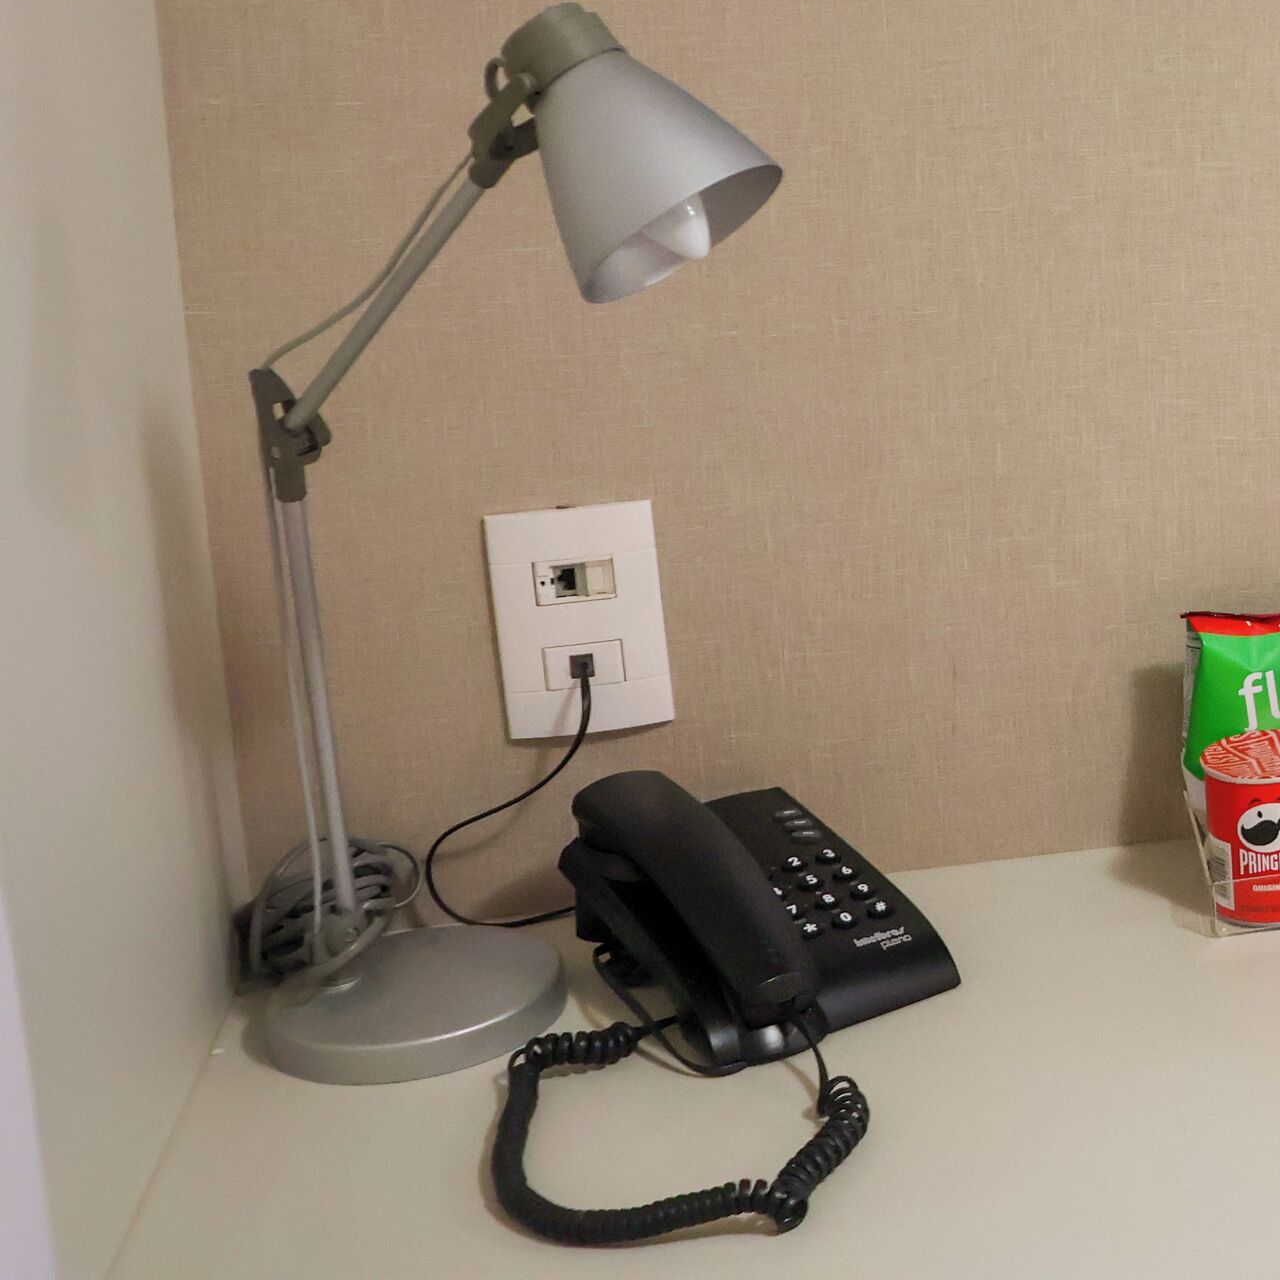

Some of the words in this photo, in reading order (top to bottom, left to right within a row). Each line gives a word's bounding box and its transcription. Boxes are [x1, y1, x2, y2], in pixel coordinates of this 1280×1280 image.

[788, 857, 800, 866] 2
[823, 849, 835, 858] 3
[806, 875, 818, 884] 5
[842, 866, 852, 875] 6
[787, 905, 797, 914] 7
[822, 894, 835, 902] 8
[857, 884, 868, 893] 9
[840, 912, 852, 922] 0
